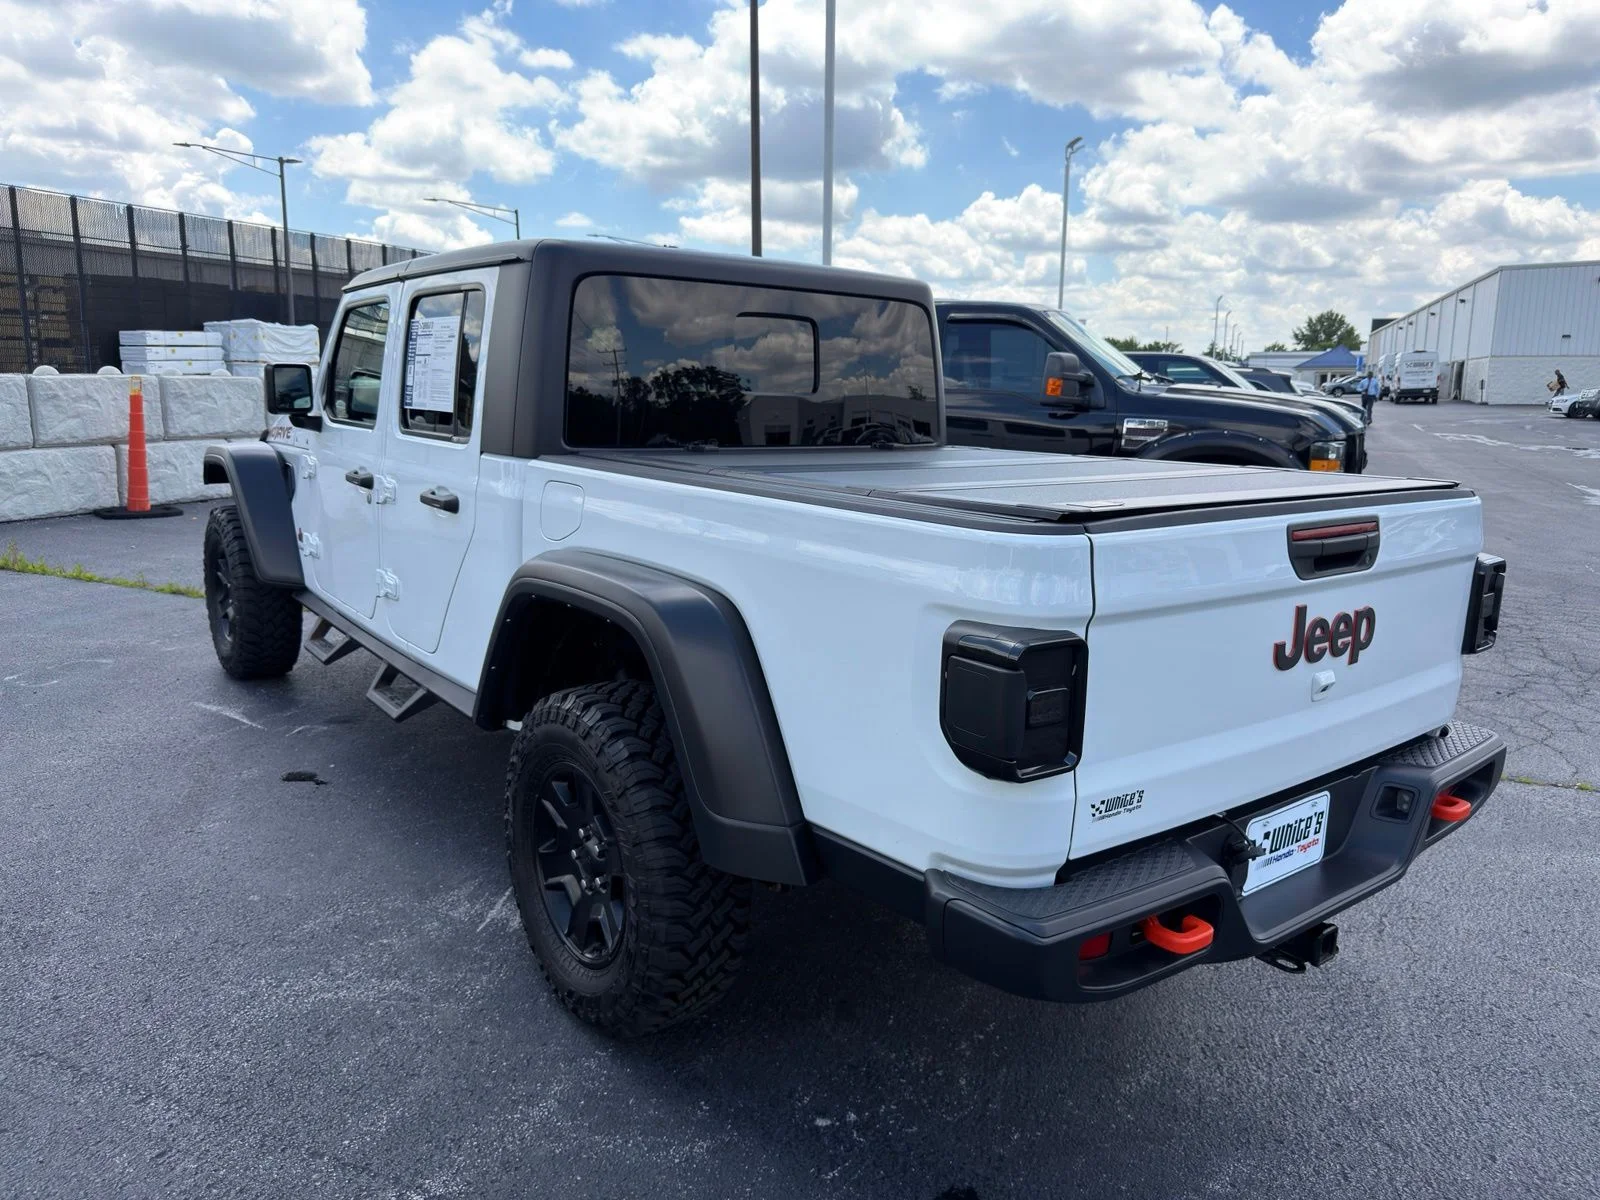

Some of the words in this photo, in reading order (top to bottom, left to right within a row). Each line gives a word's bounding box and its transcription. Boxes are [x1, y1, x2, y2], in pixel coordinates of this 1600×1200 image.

[1272, 604, 1376, 671] Jeep
[1104, 789, 1145, 813] White's
[1269, 811, 1325, 854] White's
[1273, 848, 1295, 862] Honda
[1296, 838, 1320, 853] Toyota
